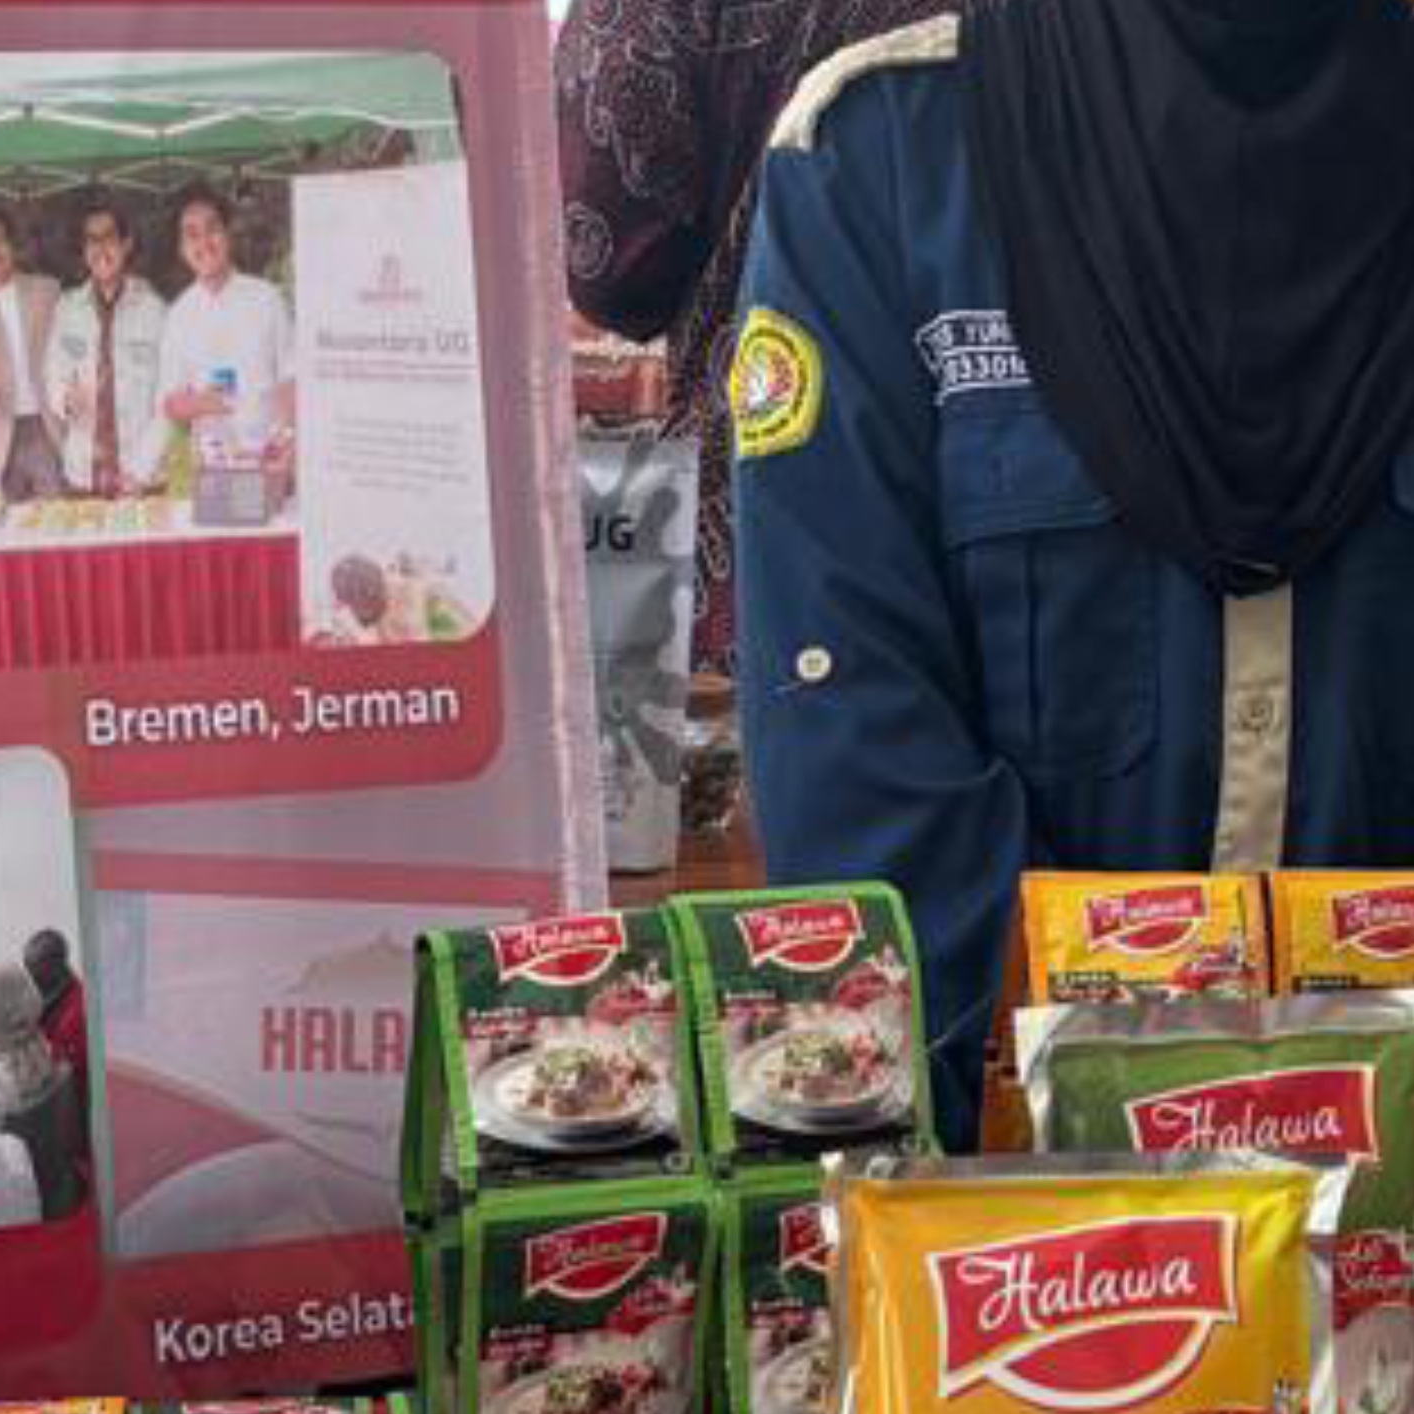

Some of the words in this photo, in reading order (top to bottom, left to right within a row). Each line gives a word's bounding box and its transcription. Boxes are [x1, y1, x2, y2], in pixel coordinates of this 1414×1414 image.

[85, 697, 281, 747] Bremen,
[293, 685, 461, 734] Jerman
[261, 1005, 405, 1074] HALA
[1151, 1096, 1343, 1154] Halawa
[957, 1250, 1196, 1332] Halawa
[155, 1314, 284, 1365] Korea
[298, 1291, 416, 1342] Selat
